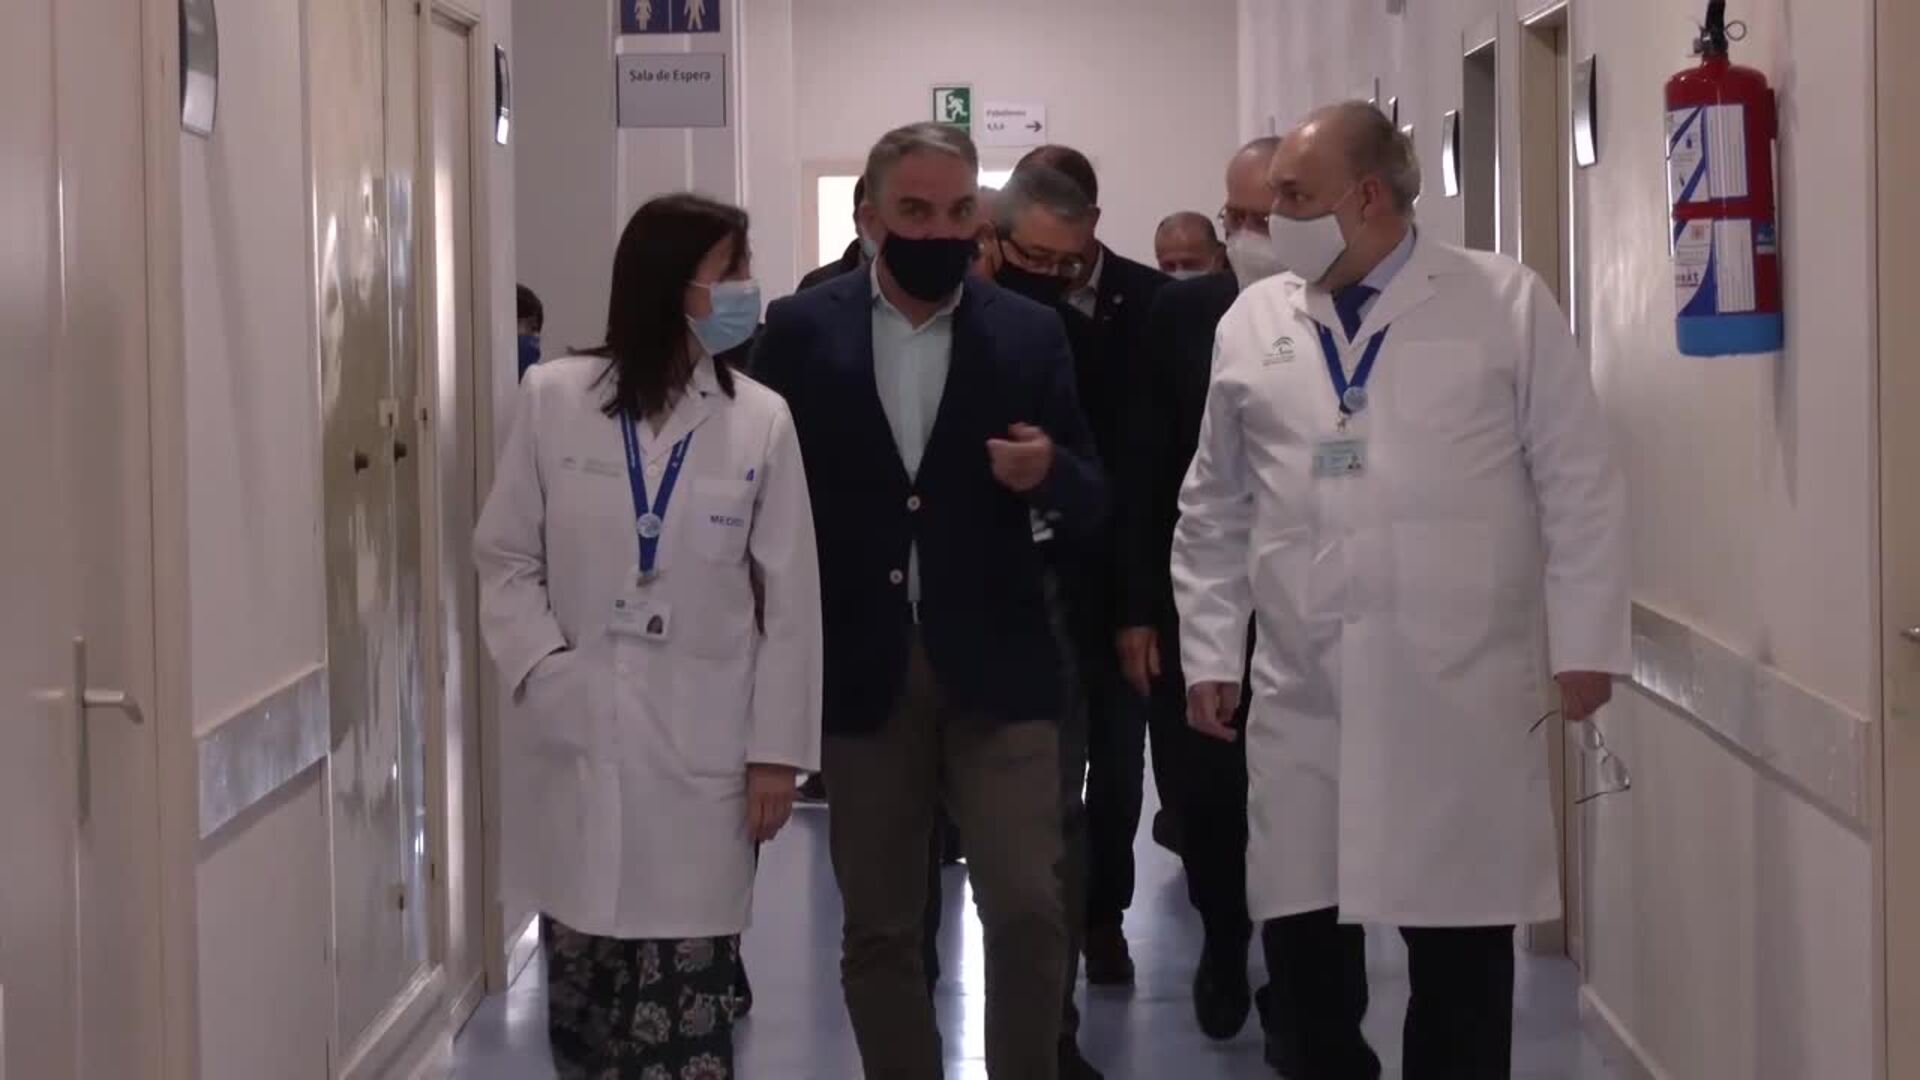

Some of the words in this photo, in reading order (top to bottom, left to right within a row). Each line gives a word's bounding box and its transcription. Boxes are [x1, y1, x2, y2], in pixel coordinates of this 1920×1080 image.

[629, 69, 653, 82] Sala
[656, 69, 670, 82] de
[673, 69, 711, 83] Espera
